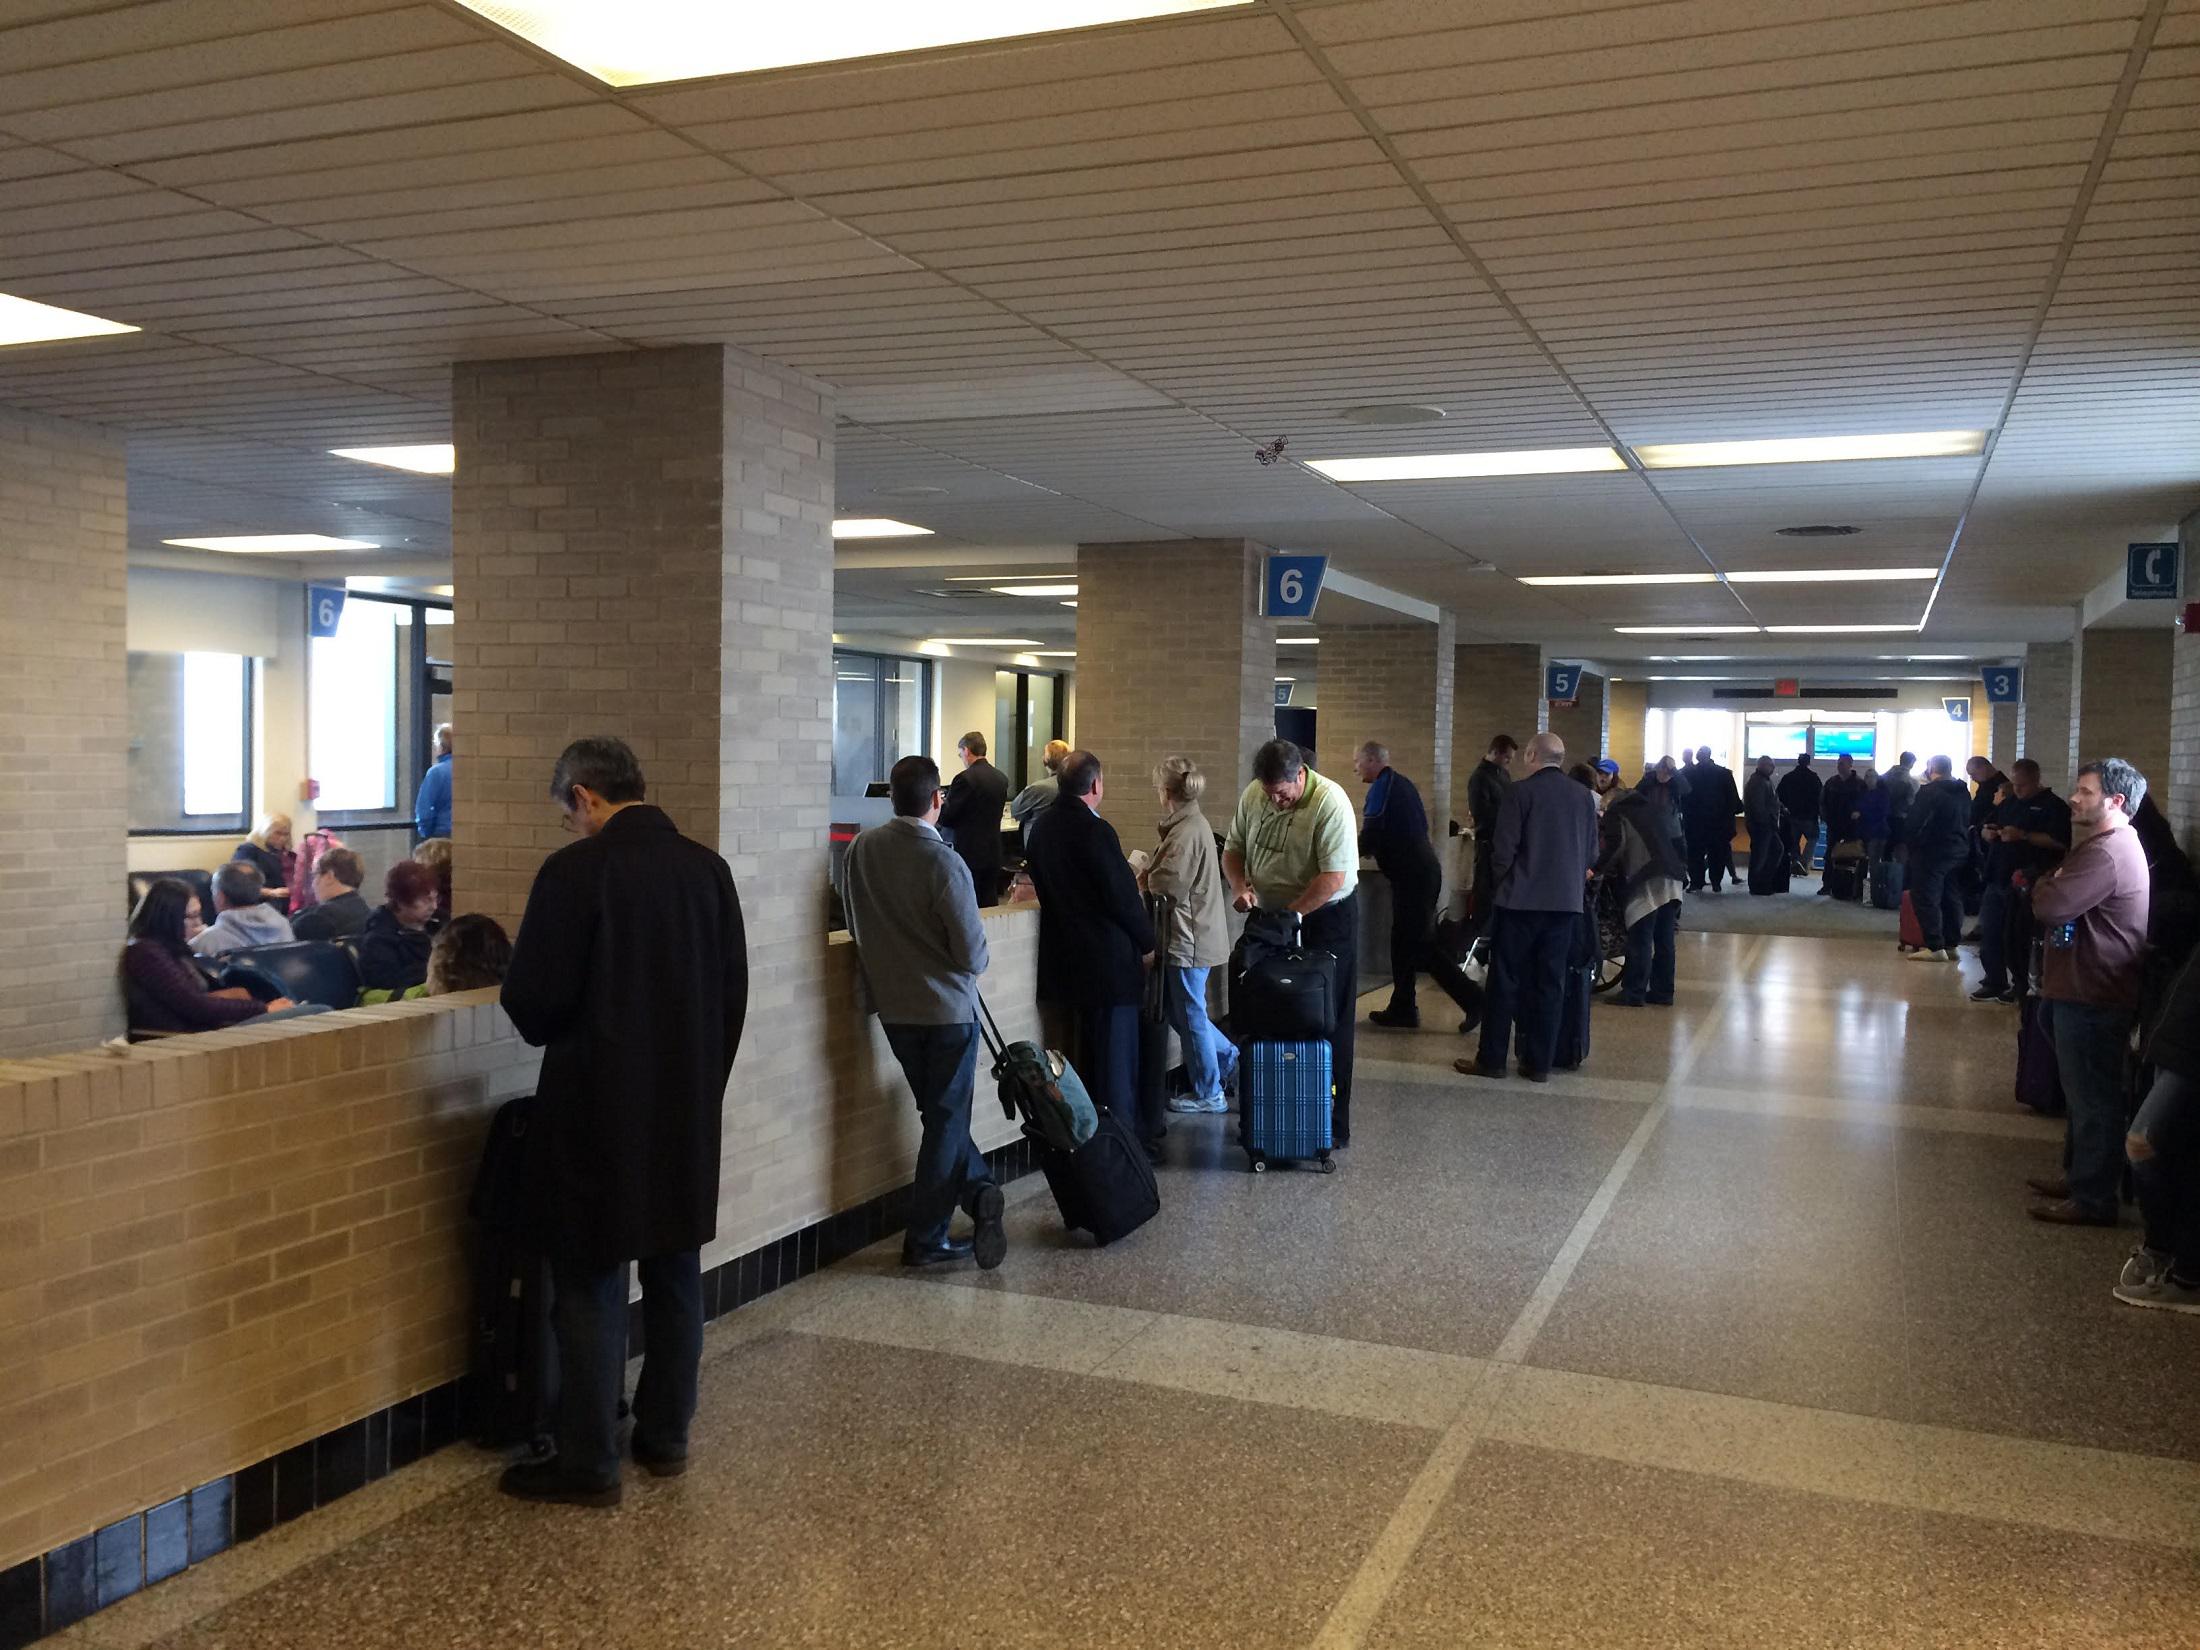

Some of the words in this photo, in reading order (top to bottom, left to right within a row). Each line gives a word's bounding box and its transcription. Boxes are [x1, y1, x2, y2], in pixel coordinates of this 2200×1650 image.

[1280, 569, 1303, 604] 6
[318, 598, 335, 627] 6
[1555, 673, 1569, 692] 5
[1994, 675, 2009, 695] 3
[1951, 703, 1963, 718] 4
